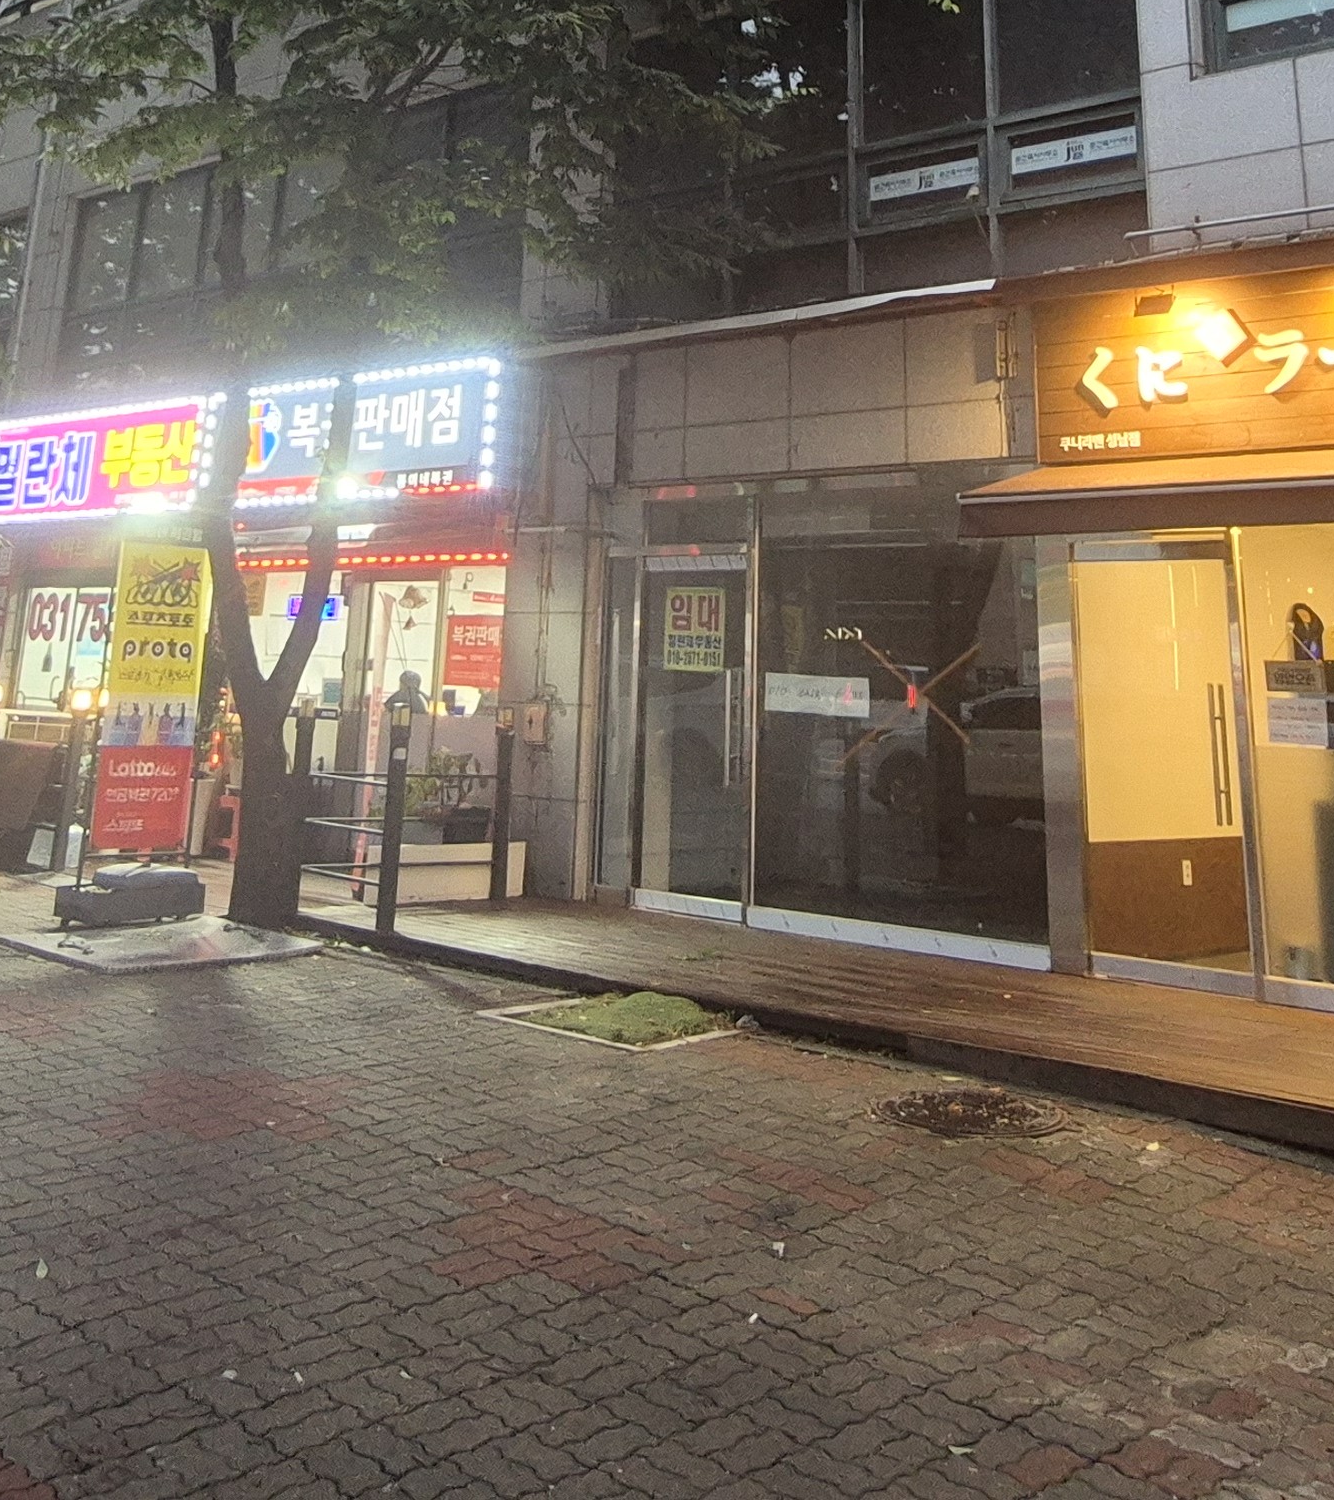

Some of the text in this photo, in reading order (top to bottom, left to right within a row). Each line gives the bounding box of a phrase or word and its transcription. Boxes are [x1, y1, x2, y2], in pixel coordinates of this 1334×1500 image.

[1078, 345, 1189, 409] くに
[287, 384, 463, 458] 복판매점
[100, 420, 197, 489] 부동산
[28, 592, 113, 642] 031 75
[452, 625, 501, 647] 복권판매
[670, 594, 720, 632] 임대
[108, 759, 155, 777] Lotto
